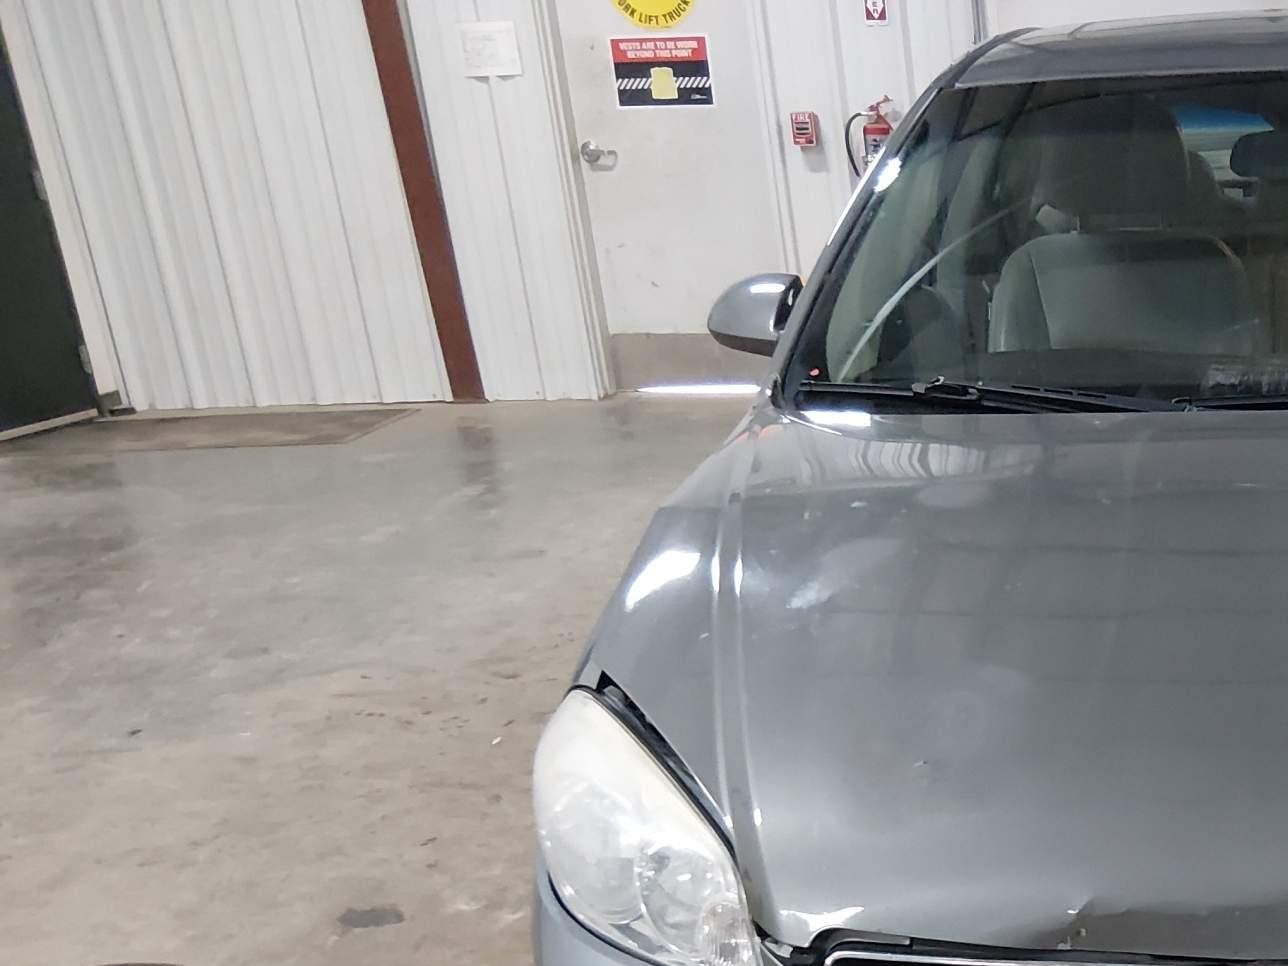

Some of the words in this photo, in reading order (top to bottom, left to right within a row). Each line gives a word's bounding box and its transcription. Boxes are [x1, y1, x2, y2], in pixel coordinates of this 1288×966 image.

[617, 0, 637, 19] ORK
[638, 12, 660, 25] LIFT
[641, 41, 655, 50] ARE
[656, 41, 666, 49] TO
[666, 41, 676, 49] BE
[655, 49, 671, 58] THIS
[671, 49, 692, 58] POINT
[791, 112, 811, 121] FIRE
